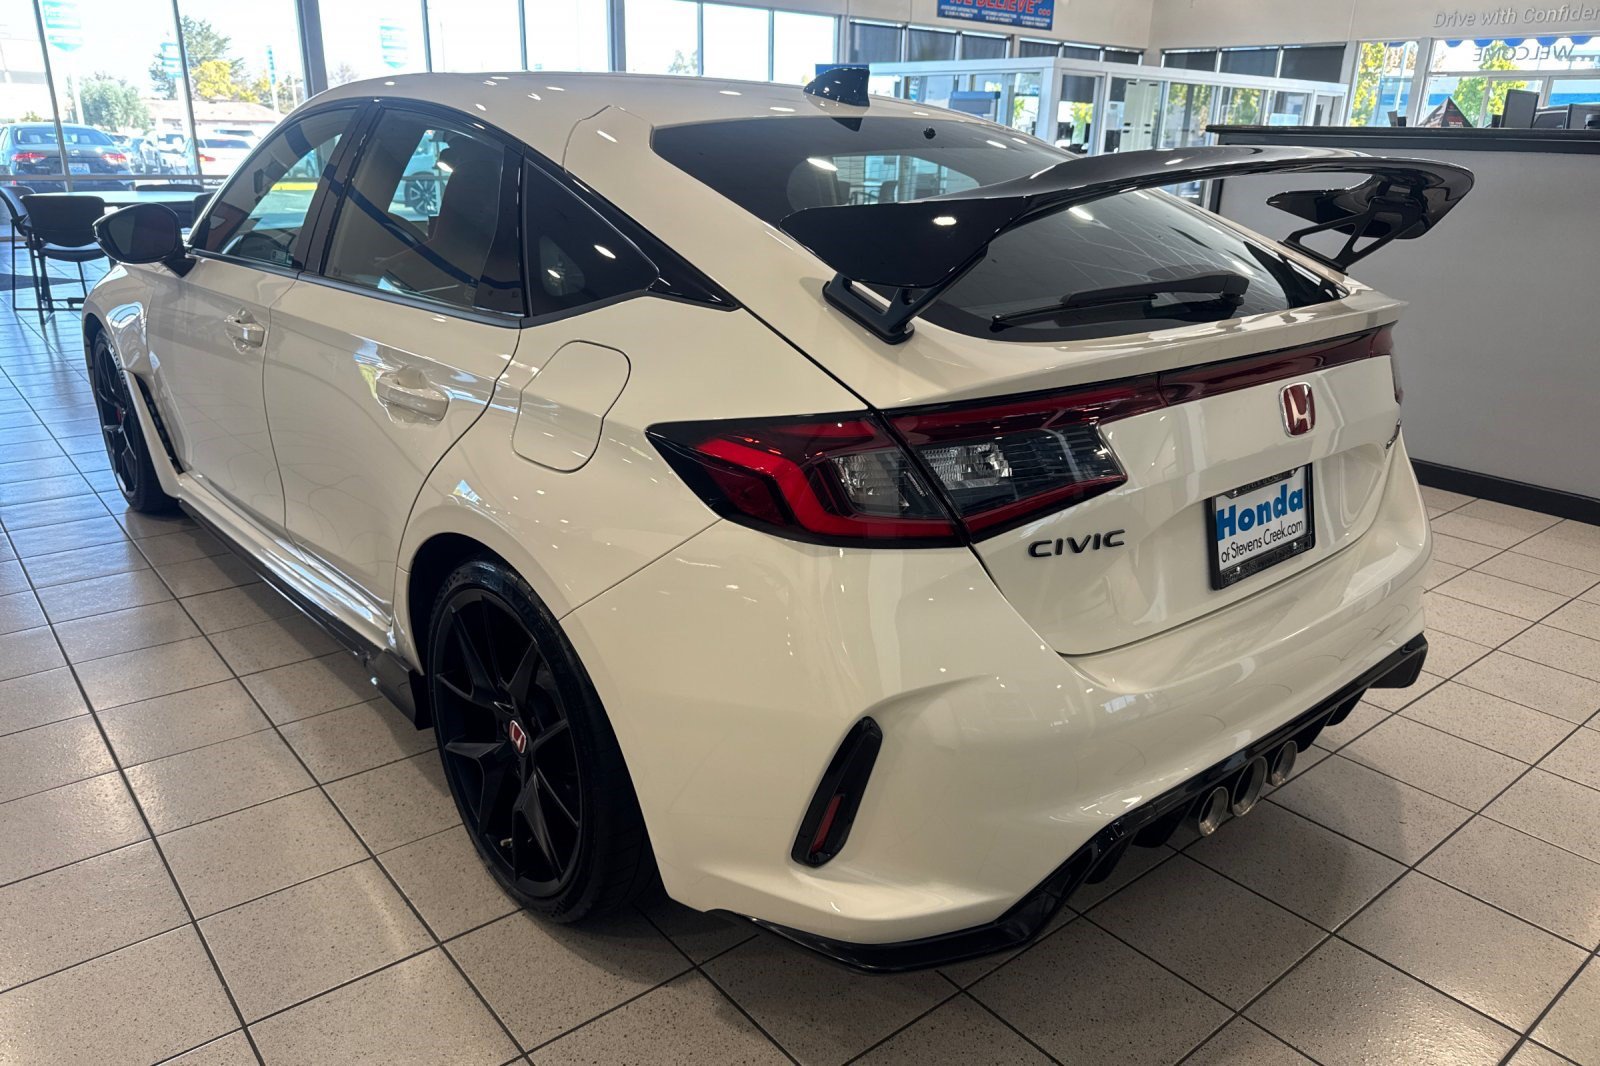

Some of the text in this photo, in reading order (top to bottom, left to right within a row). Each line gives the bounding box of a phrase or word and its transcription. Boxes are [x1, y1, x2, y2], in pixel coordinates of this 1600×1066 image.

[1435, 11, 1475, 27] Drive
[1481, 8, 1517, 25] with
[1216, 484, 1303, 541] Honda
[1028, 529, 1125, 557] CIVIC
[1221, 520, 1304, 563] of Stevens Creek.com
